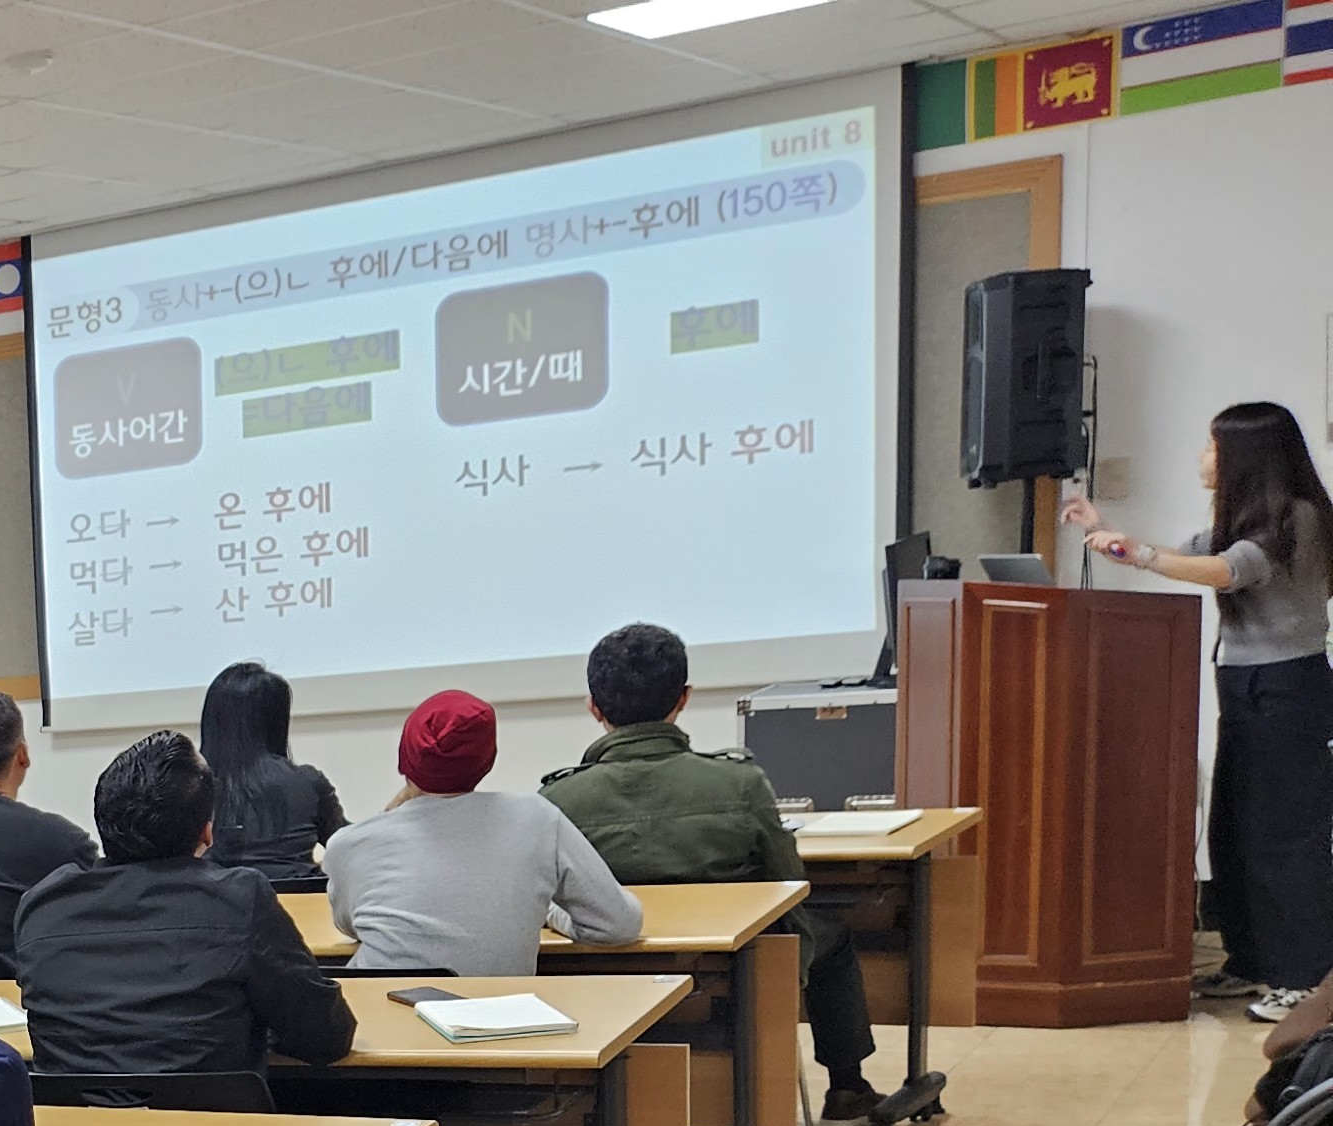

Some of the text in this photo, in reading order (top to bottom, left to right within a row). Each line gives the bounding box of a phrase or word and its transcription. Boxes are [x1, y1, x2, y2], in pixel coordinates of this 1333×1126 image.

[770, 119, 862, 158] unit 8
[46, 296, 123, 339] 문형3
[327, 228, 509, 289] 후에/다음에
[525, 195, 700, 258] 명사+-후에
[717, 171, 838, 223] (150쪽)
[506, 308, 533, 344] N
[672, 300, 759, 347] 후에
[327, 330, 401, 373] 후에
[458, 349, 583, 397] 시간/때
[68, 409, 188, 459] 동사어간
[455, 418, 815, 497] 식사 식사 후에
[66, 481, 332, 544] 오다 온 후에
[69, 526, 370, 595] 먹다 먹은 후에
[68, 577, 333, 647] 살다 산 후에
